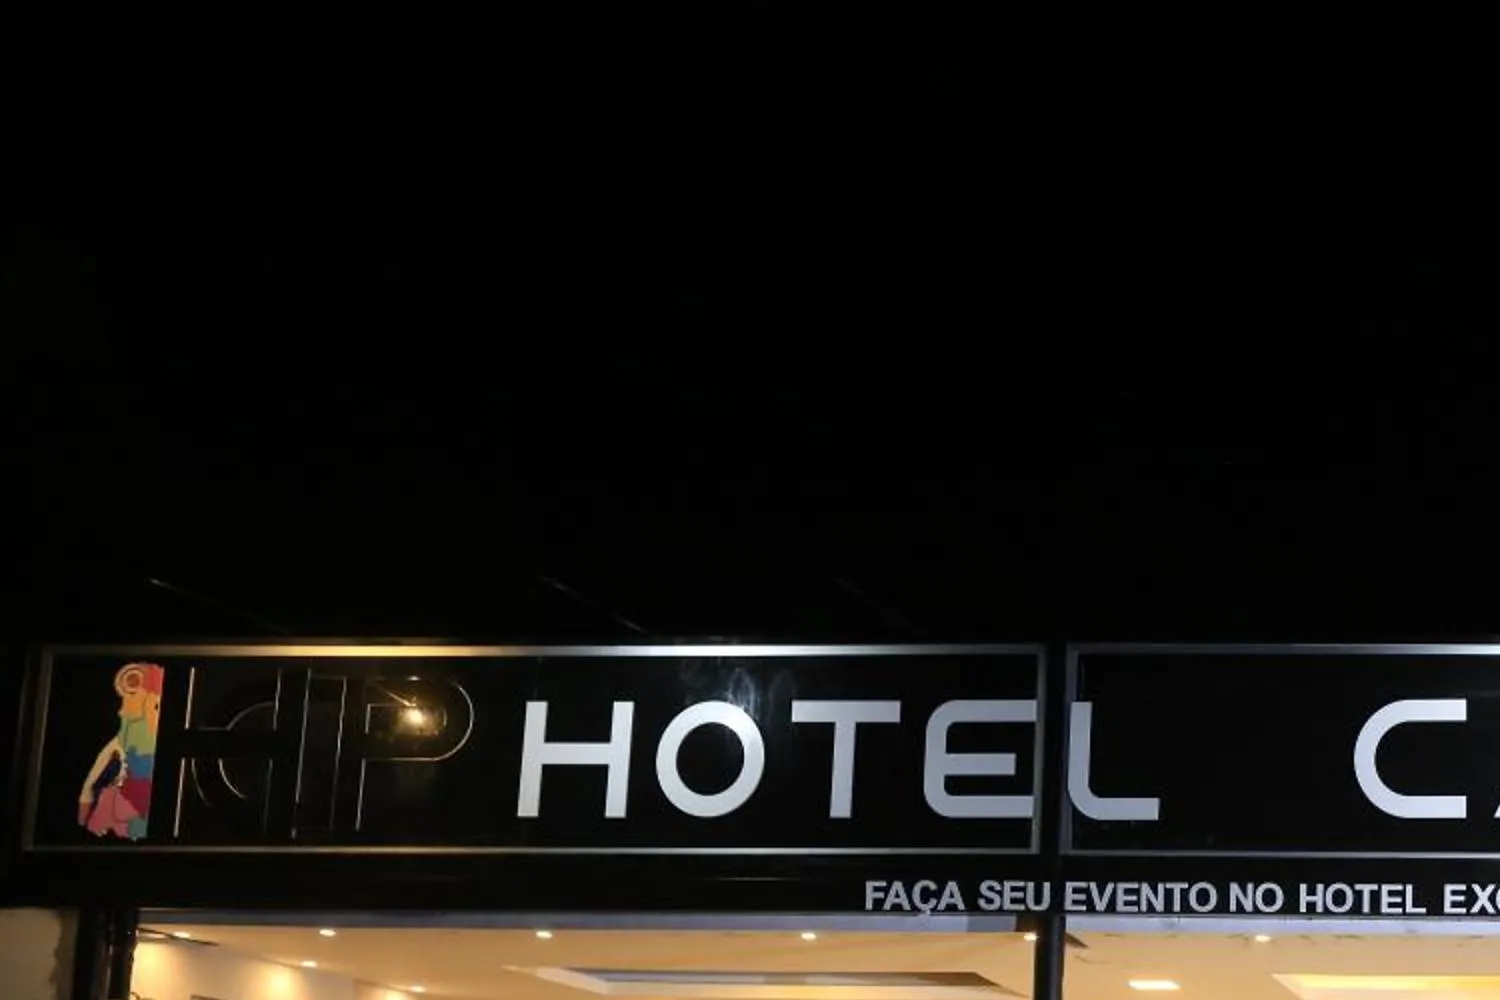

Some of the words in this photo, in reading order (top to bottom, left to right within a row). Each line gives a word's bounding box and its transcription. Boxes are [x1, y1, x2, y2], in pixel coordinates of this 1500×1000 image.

[517, 699, 1160, 820] HOTEL
[865, 880, 967, 915] FAÇA
[978, 880, 1052, 912] SEU
[1064, 881, 1218, 914] EVENTO
[1229, 882, 1285, 914] NO
[1298, 883, 1428, 915] HOTEL
